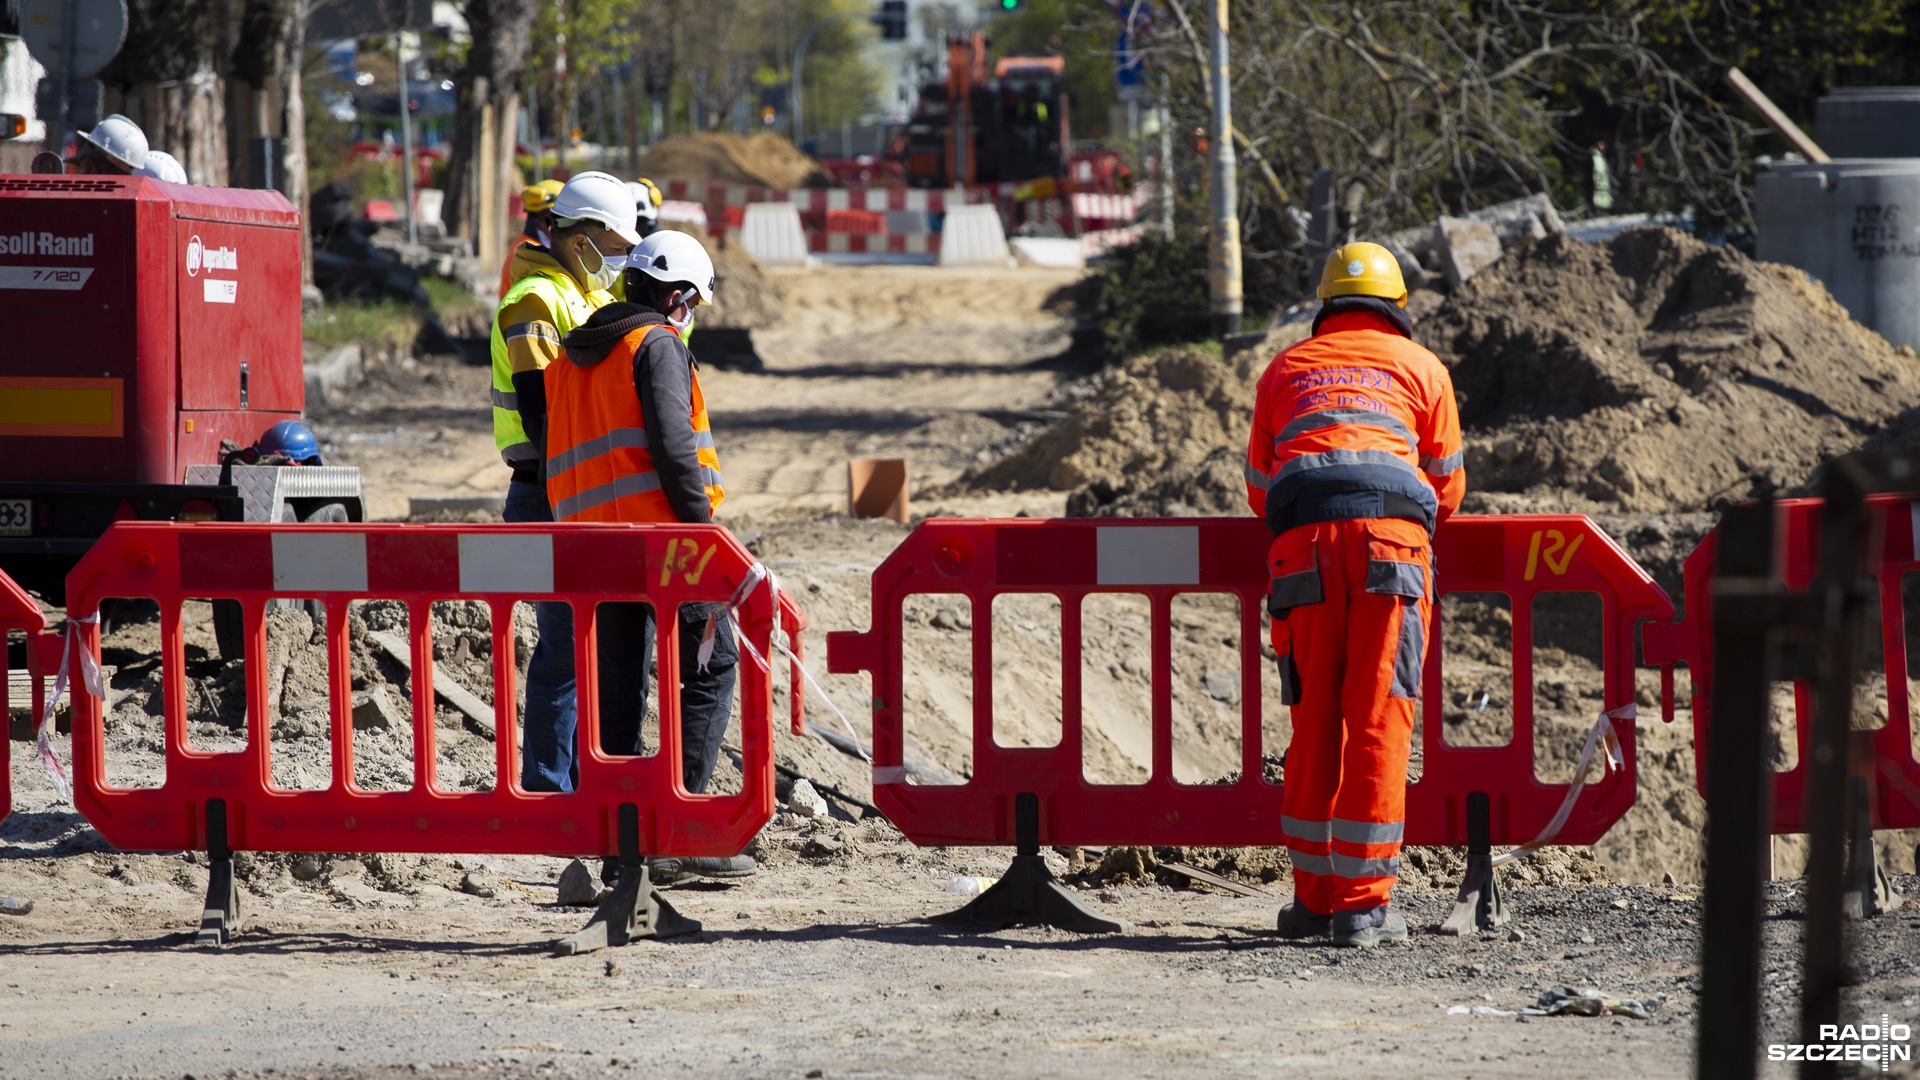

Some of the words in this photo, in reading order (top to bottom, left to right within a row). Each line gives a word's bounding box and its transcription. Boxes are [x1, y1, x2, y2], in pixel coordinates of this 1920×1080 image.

[33, 270, 80, 282] 7/120
[1290, 369, 1391, 393] TOMALEX
[1337, 394, 1389, 415] InSan
